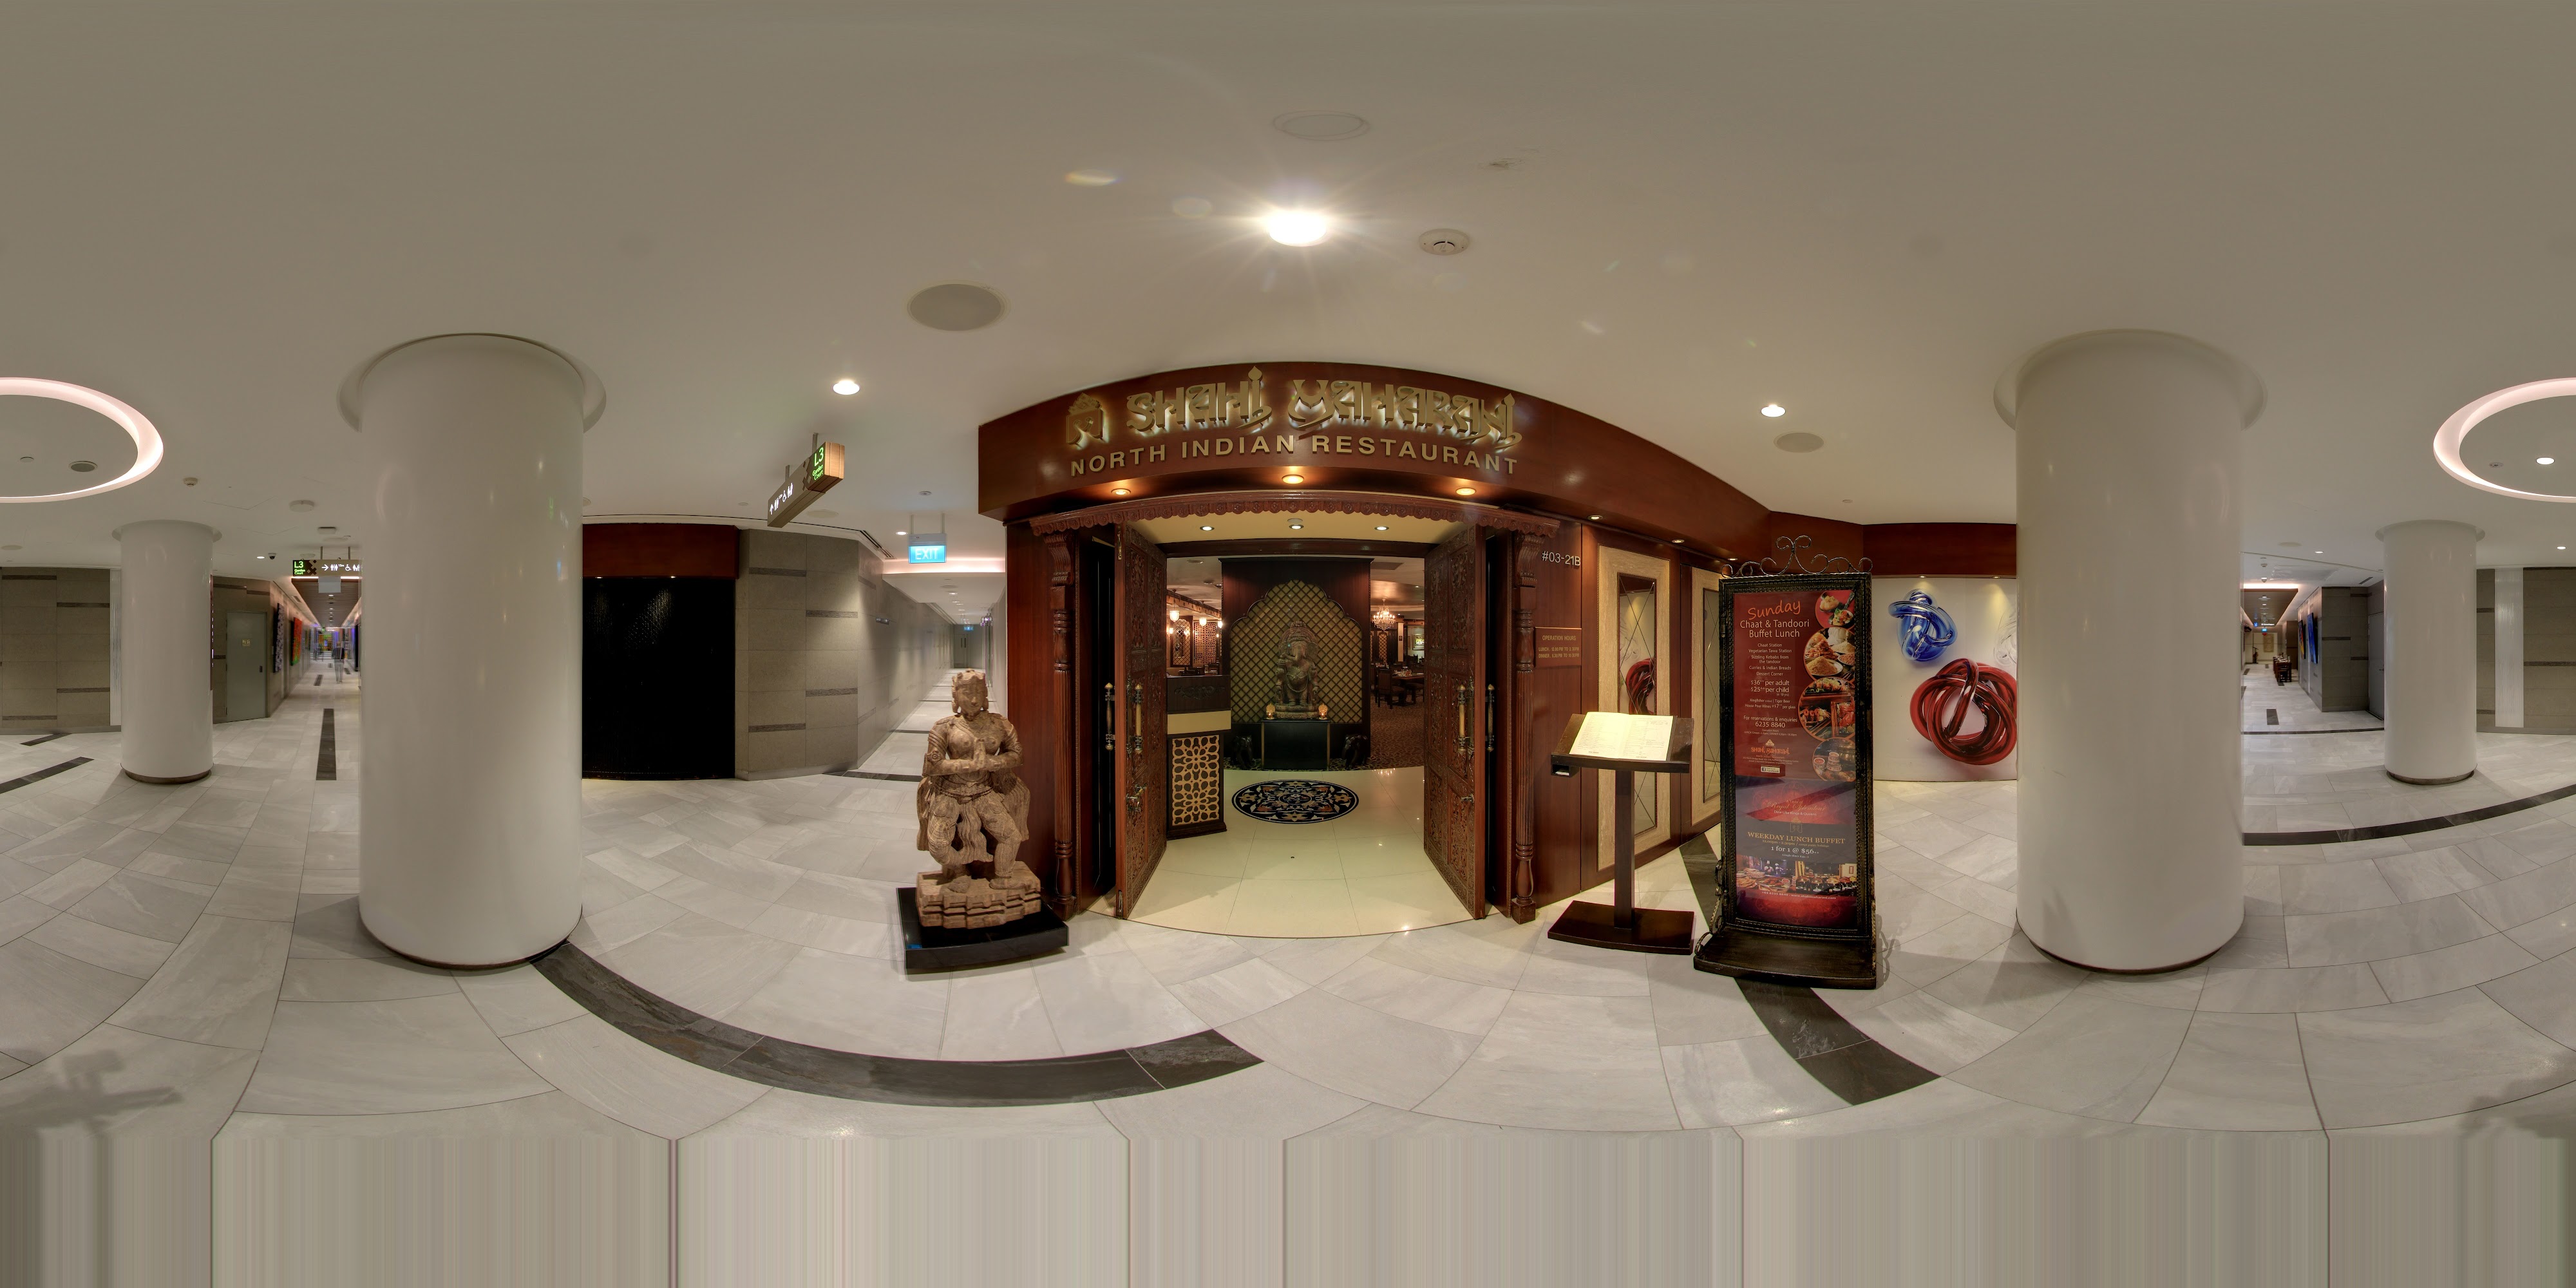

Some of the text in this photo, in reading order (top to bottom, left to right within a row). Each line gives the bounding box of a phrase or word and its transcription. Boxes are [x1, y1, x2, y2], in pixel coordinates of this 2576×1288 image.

[1126, 366, 1522, 450] SHAHI MAHARANI
[814, 447, 824, 466] L3
[1071, 435, 1518, 477] NORTH INDIAN RESTAURANT
[812, 464, 824, 476] Garden
[814, 470, 823, 480] Court
[915, 548, 938, 560] EXIT
[1542, 551, 1581, 566] #03-21B
[1748, 600, 1801, 620] Sunday
[1740, 620, 1762, 628] Chaat
[1773, 619, 1810, 628] Tandoori
[1749, 629, 1800, 638] Buffet Lunch
[1767, 801, 1827, 812] Regal Splendour
[1748, 832, 1784, 841] WEEKDAY
